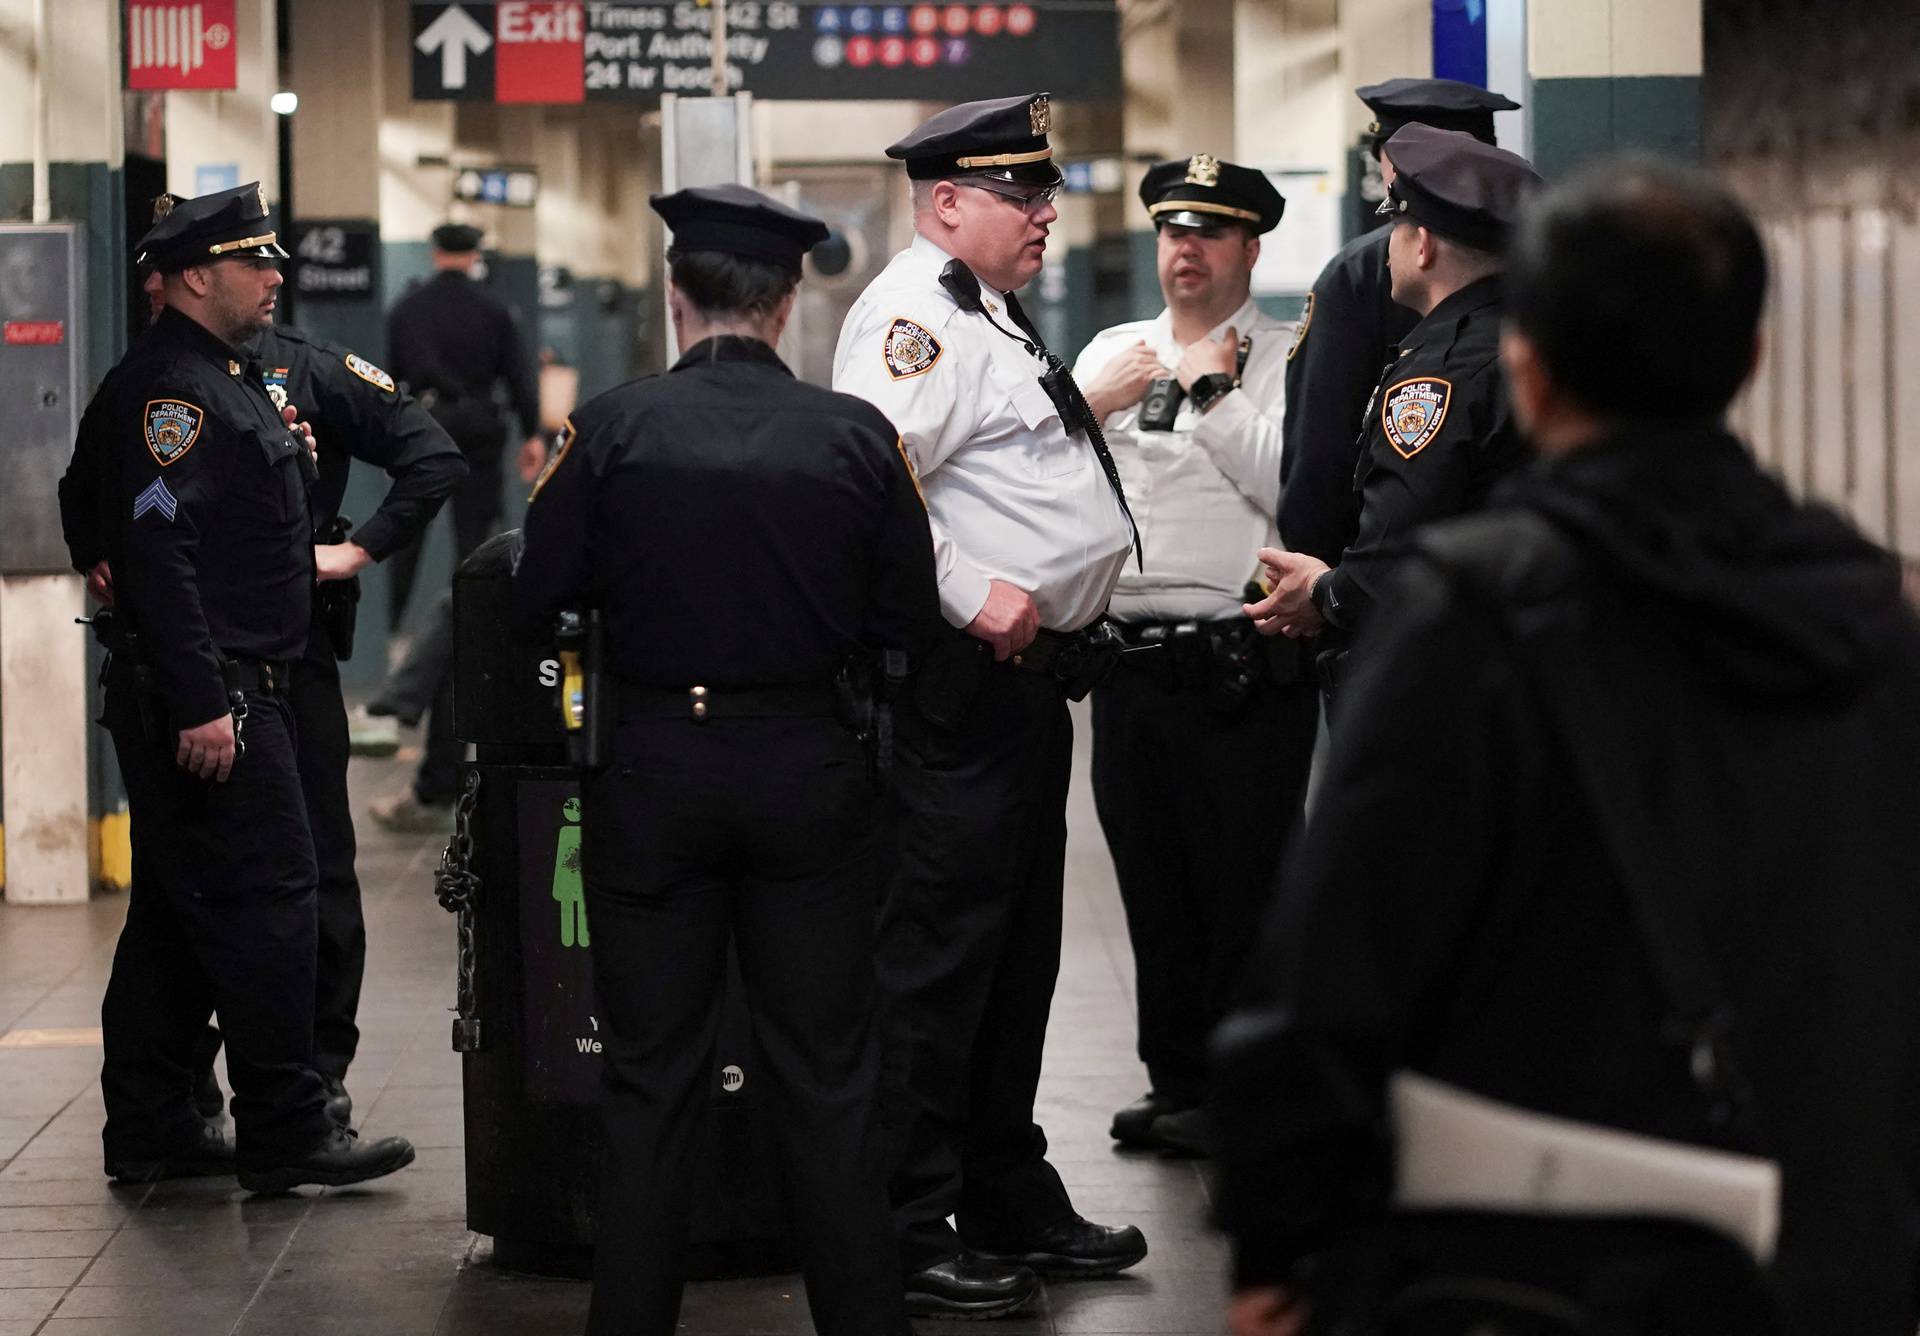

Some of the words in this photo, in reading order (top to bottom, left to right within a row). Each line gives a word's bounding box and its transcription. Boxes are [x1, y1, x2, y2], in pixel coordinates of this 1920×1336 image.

[498, 2, 583, 43] Exit
[590, 4, 667, 29] Times
[767, 4, 798, 30] St
[585, 32, 640, 58] Port
[585, 62, 620, 89] 24
[627, 62, 657, 88] hr
[299, 227, 346, 262] 42
[299, 264, 369, 291] Street
[892, 325, 936, 355] DEPARTMENT
[906, 322, 931, 341] POLICE
[887, 356, 895, 366] OF
[901, 367, 916, 375] NEW
[1389, 392, 1443, 407] DEPARTMENT
[1401, 383, 1431, 394] POLICE
[150, 411, 196, 425] DEPARTMENT
[161, 403, 189, 414] POLICE
[147, 426, 156, 443] CITY
[152, 443, 161, 453] OF
[1386, 415, 1396, 434] CITY
[1393, 434, 1403, 445] OF
[1413, 430, 1430, 448] NEW
[1428, 407, 1443, 431] YORK
[169, 446, 184, 459] NEW
[181, 429, 196, 447] YORK
[575, 1038, 602, 1053] We
